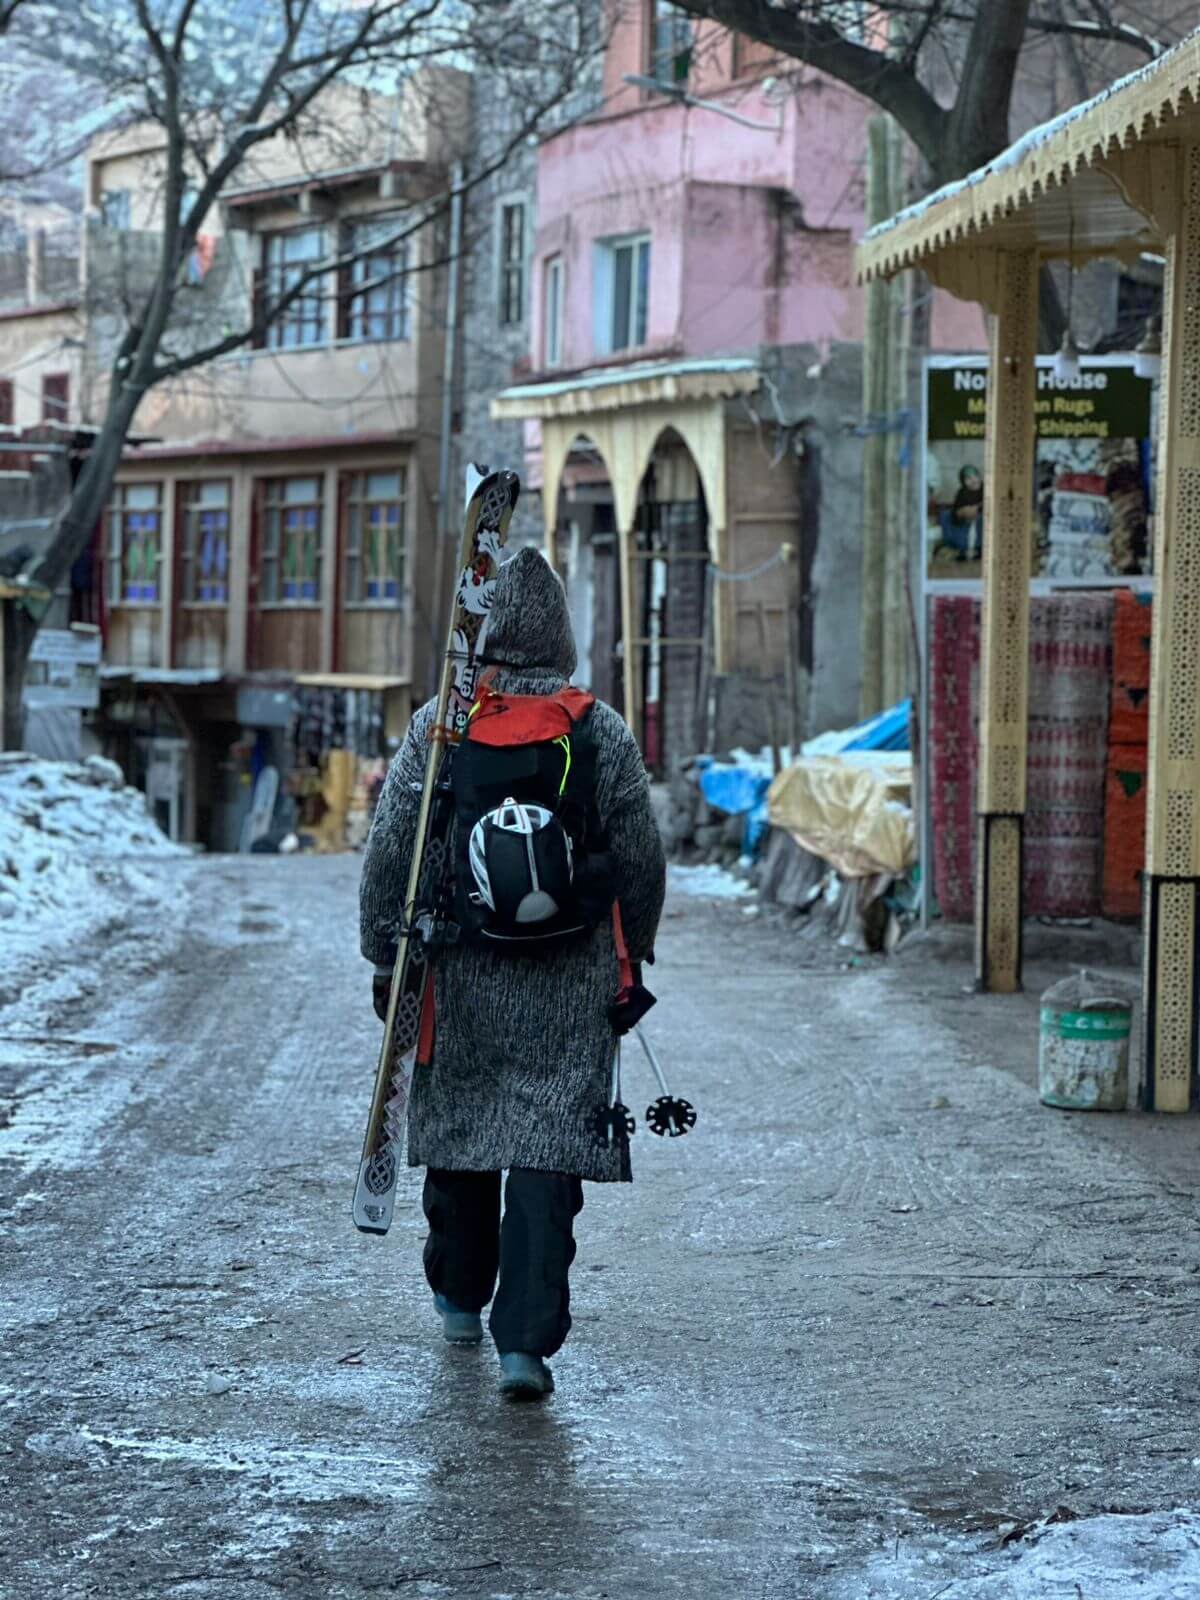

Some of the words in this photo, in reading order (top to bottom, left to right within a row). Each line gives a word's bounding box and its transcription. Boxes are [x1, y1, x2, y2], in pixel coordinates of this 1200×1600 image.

[1038, 370, 1108, 390] House
[1054, 397, 1095, 416] Rugs
[1039, 418, 1109, 437] Shipping
